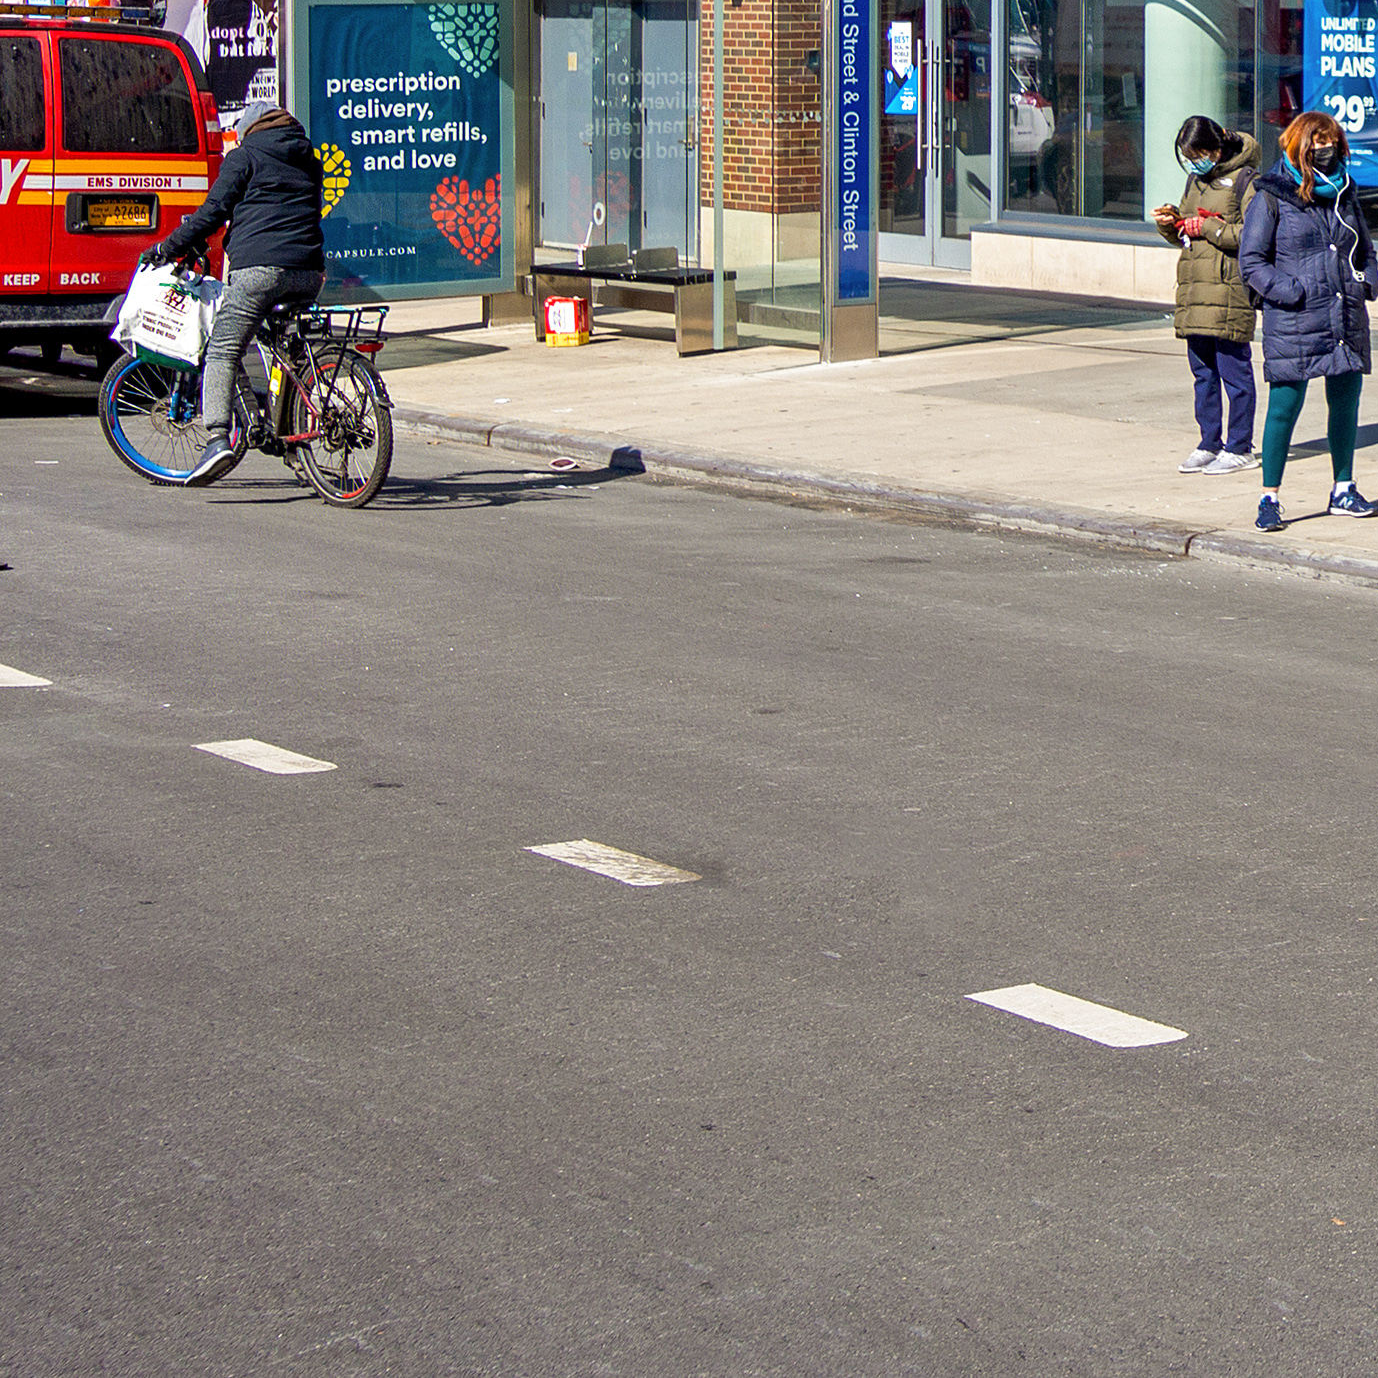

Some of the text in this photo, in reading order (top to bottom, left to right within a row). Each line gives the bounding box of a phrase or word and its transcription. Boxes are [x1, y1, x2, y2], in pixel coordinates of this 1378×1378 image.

[208, 26, 244, 42] dopt
[894, 35, 909, 44] BEST
[1321, 34, 1375, 53] MOBILE
[842, 23, 859, 85] Street
[1321, 55, 1376, 78] PLANS
[326, 71, 461, 98] prescription
[842, 92, 859, 105] &
[338, 100, 434, 122] delivery,
[351, 122, 488, 145] smart refills,
[842, 110, 860, 184] Clinton
[364, 148, 457, 171] and love
[87, 177, 182, 188] EMS DIVISION 1
[842, 190, 859, 252] Street
[326, 246, 416, 259] CAPSULE.COM
[3, 274, 40, 286] KEEP
[60, 273, 100, 285] BACK
